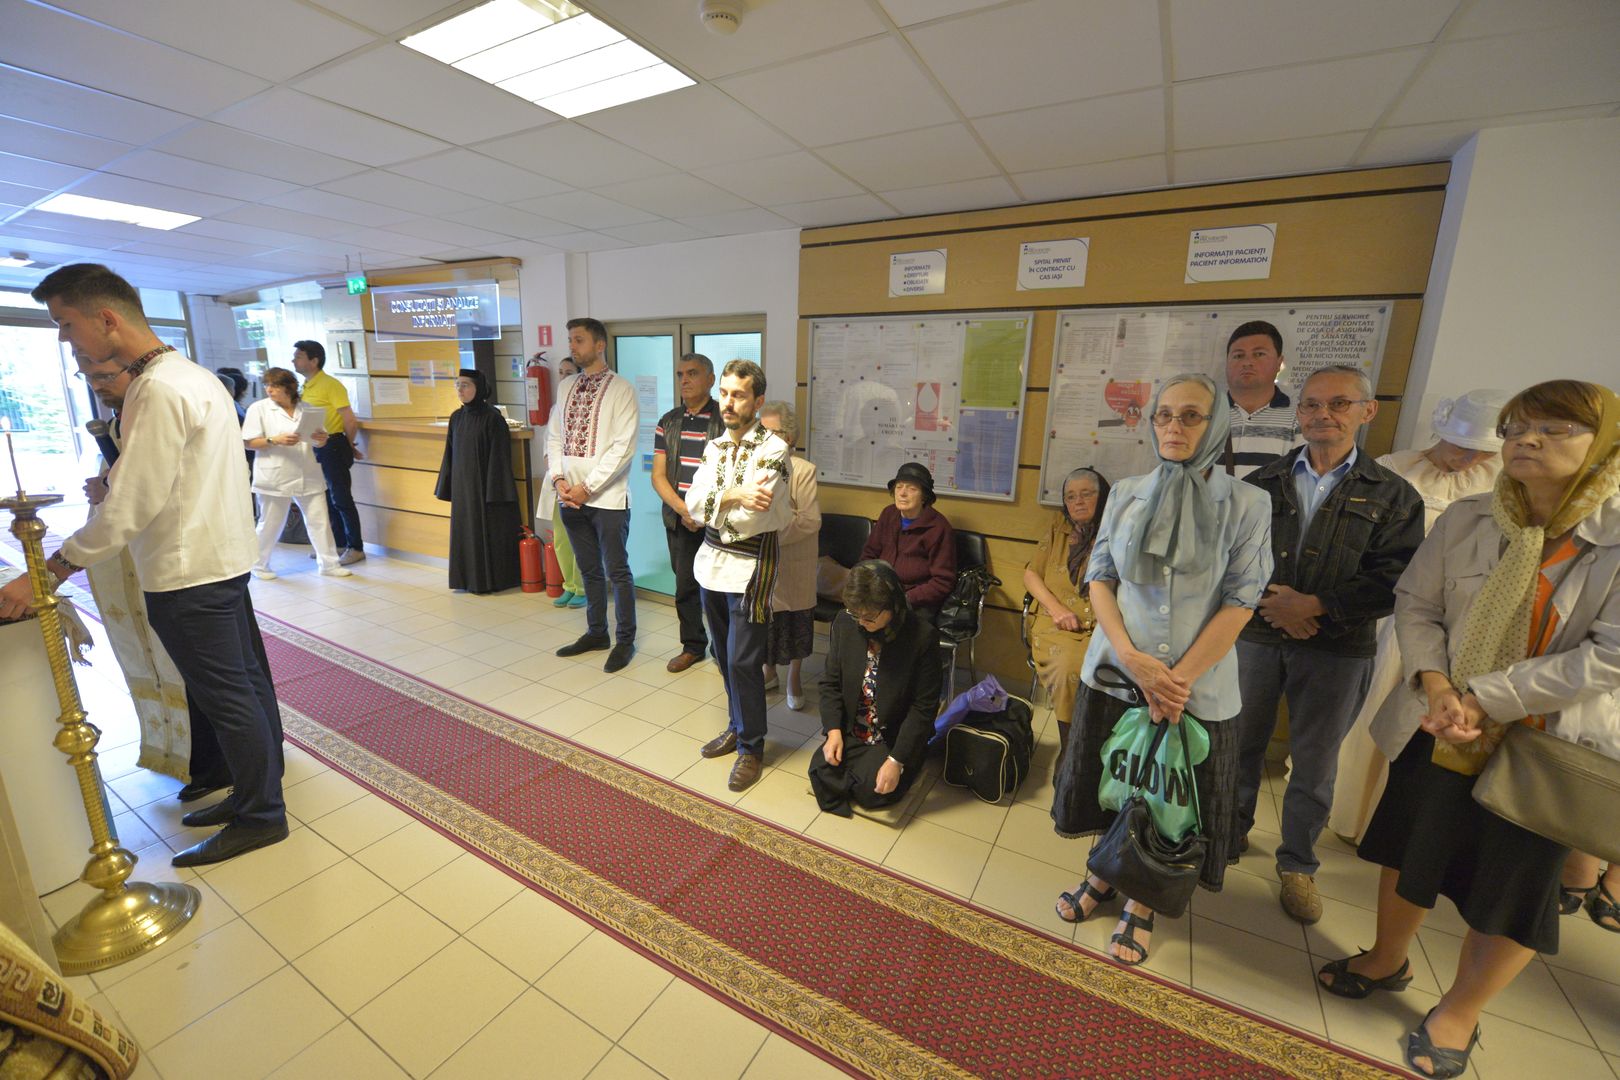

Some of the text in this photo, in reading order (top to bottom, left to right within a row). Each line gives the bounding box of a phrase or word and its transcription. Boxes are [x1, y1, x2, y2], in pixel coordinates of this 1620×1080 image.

[1190, 257, 1268, 267] PACIENT INFORMATION
[445, 296, 479, 311] ANALIZE
